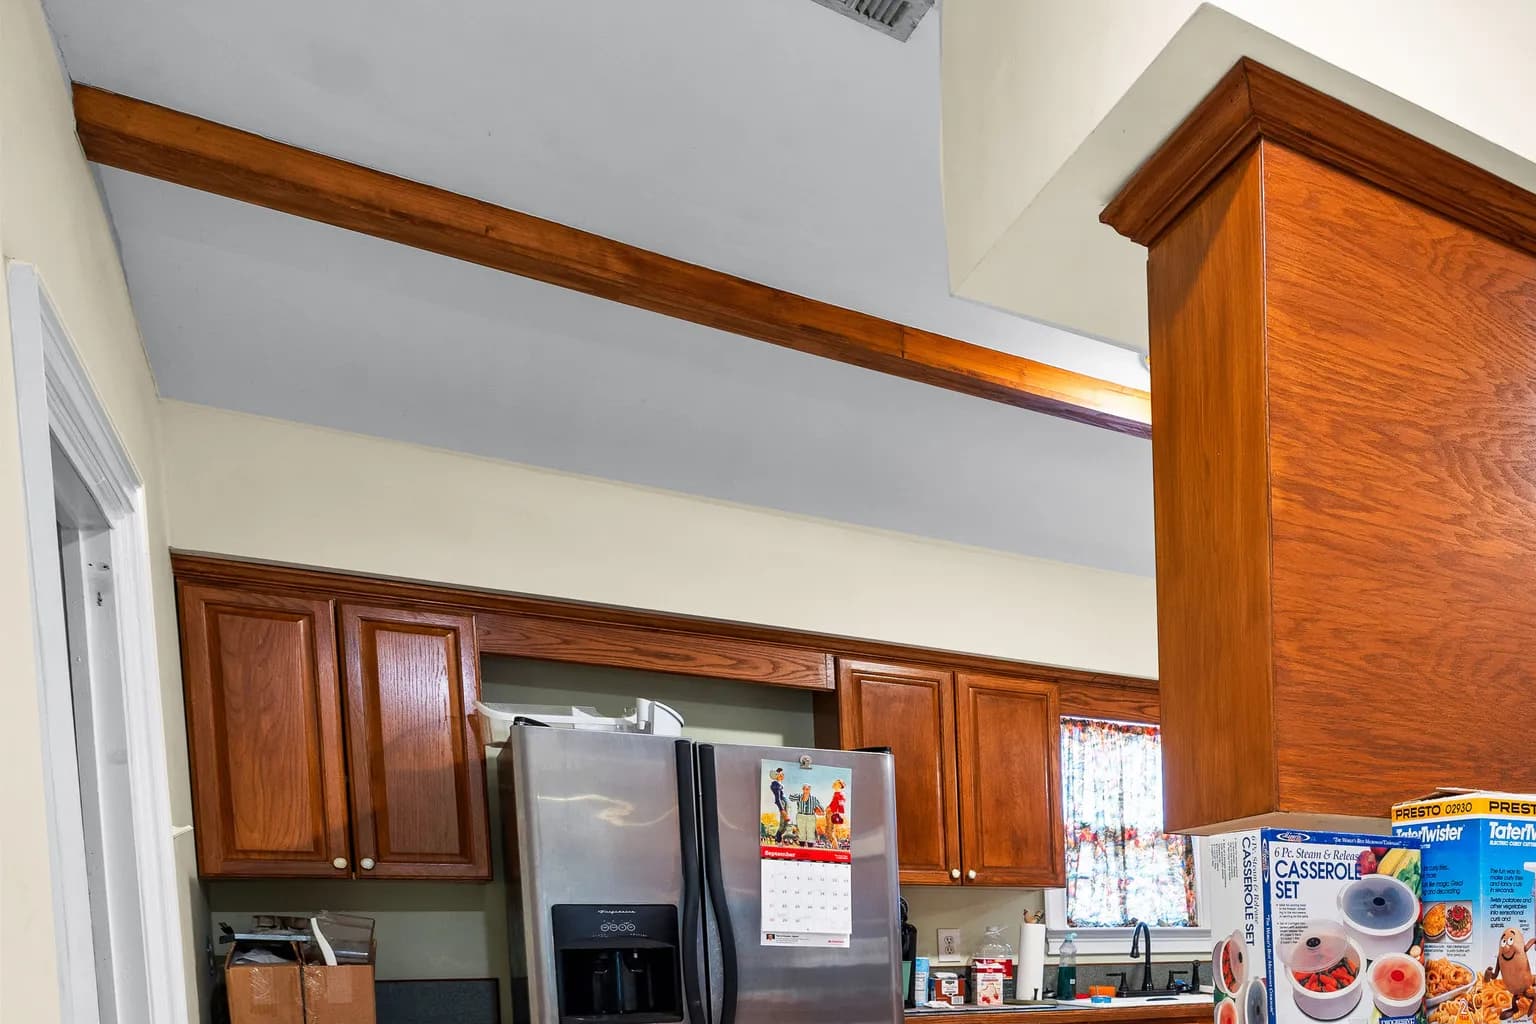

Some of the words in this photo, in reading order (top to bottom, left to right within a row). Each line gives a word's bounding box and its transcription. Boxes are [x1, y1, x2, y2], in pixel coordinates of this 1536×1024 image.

[1396, 805, 1440, 819] PRESTO
[1445, 802, 1472, 814] 02930
[1274, 847, 1280, 857] 6
[1282, 847, 1294, 858] Pc.
[1296, 848, 1321, 859] Steam
[1323, 849, 1331, 859] &
[1333, 850, 1360, 861] Releas
[1242, 836, 1254, 920] CASSEROLE
[1275, 860, 1362, 880] CASSEROLE
[1275, 880, 1300, 899] SET
[1245, 922, 1255, 946] SET
